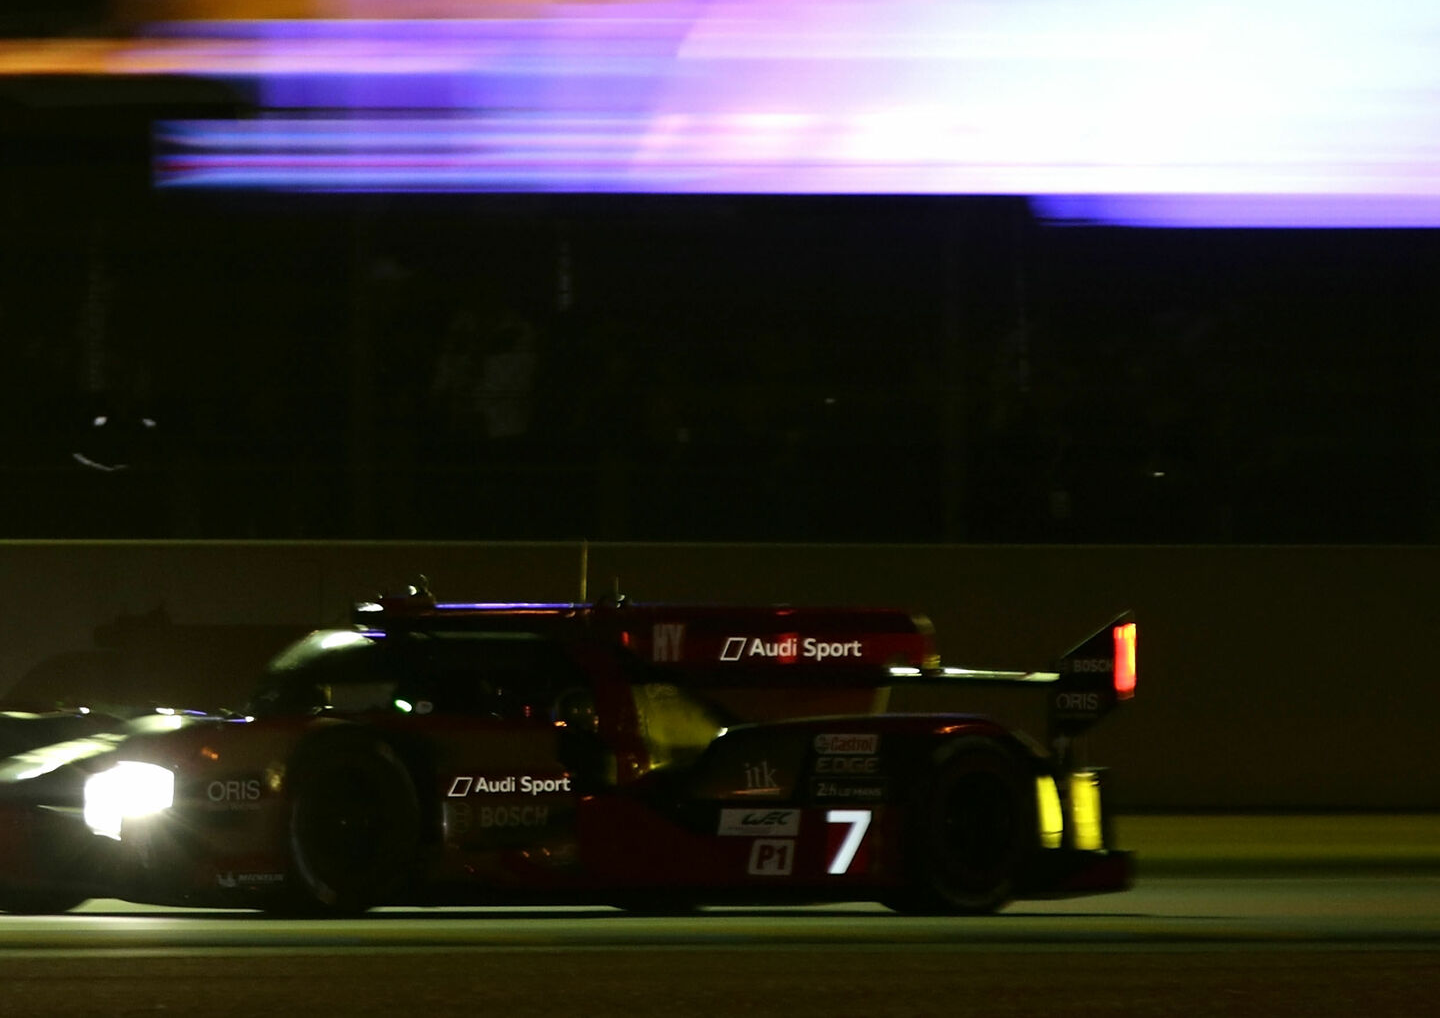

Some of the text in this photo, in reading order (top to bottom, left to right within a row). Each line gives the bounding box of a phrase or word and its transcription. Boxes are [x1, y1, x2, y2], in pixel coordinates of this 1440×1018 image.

[748, 637, 863, 662] Audi Sport
[1073, 658, 1113, 672] BOSCH
[1056, 693, 1099, 710] ORIS
[815, 757, 881, 773] EDGE
[207, 780, 261, 802] ORIS
[474, 775, 571, 796] Audi Sport
[480, 805, 549, 828] BOSCH
[825, 809, 872, 875] 7
[756, 844, 787, 870] P1
